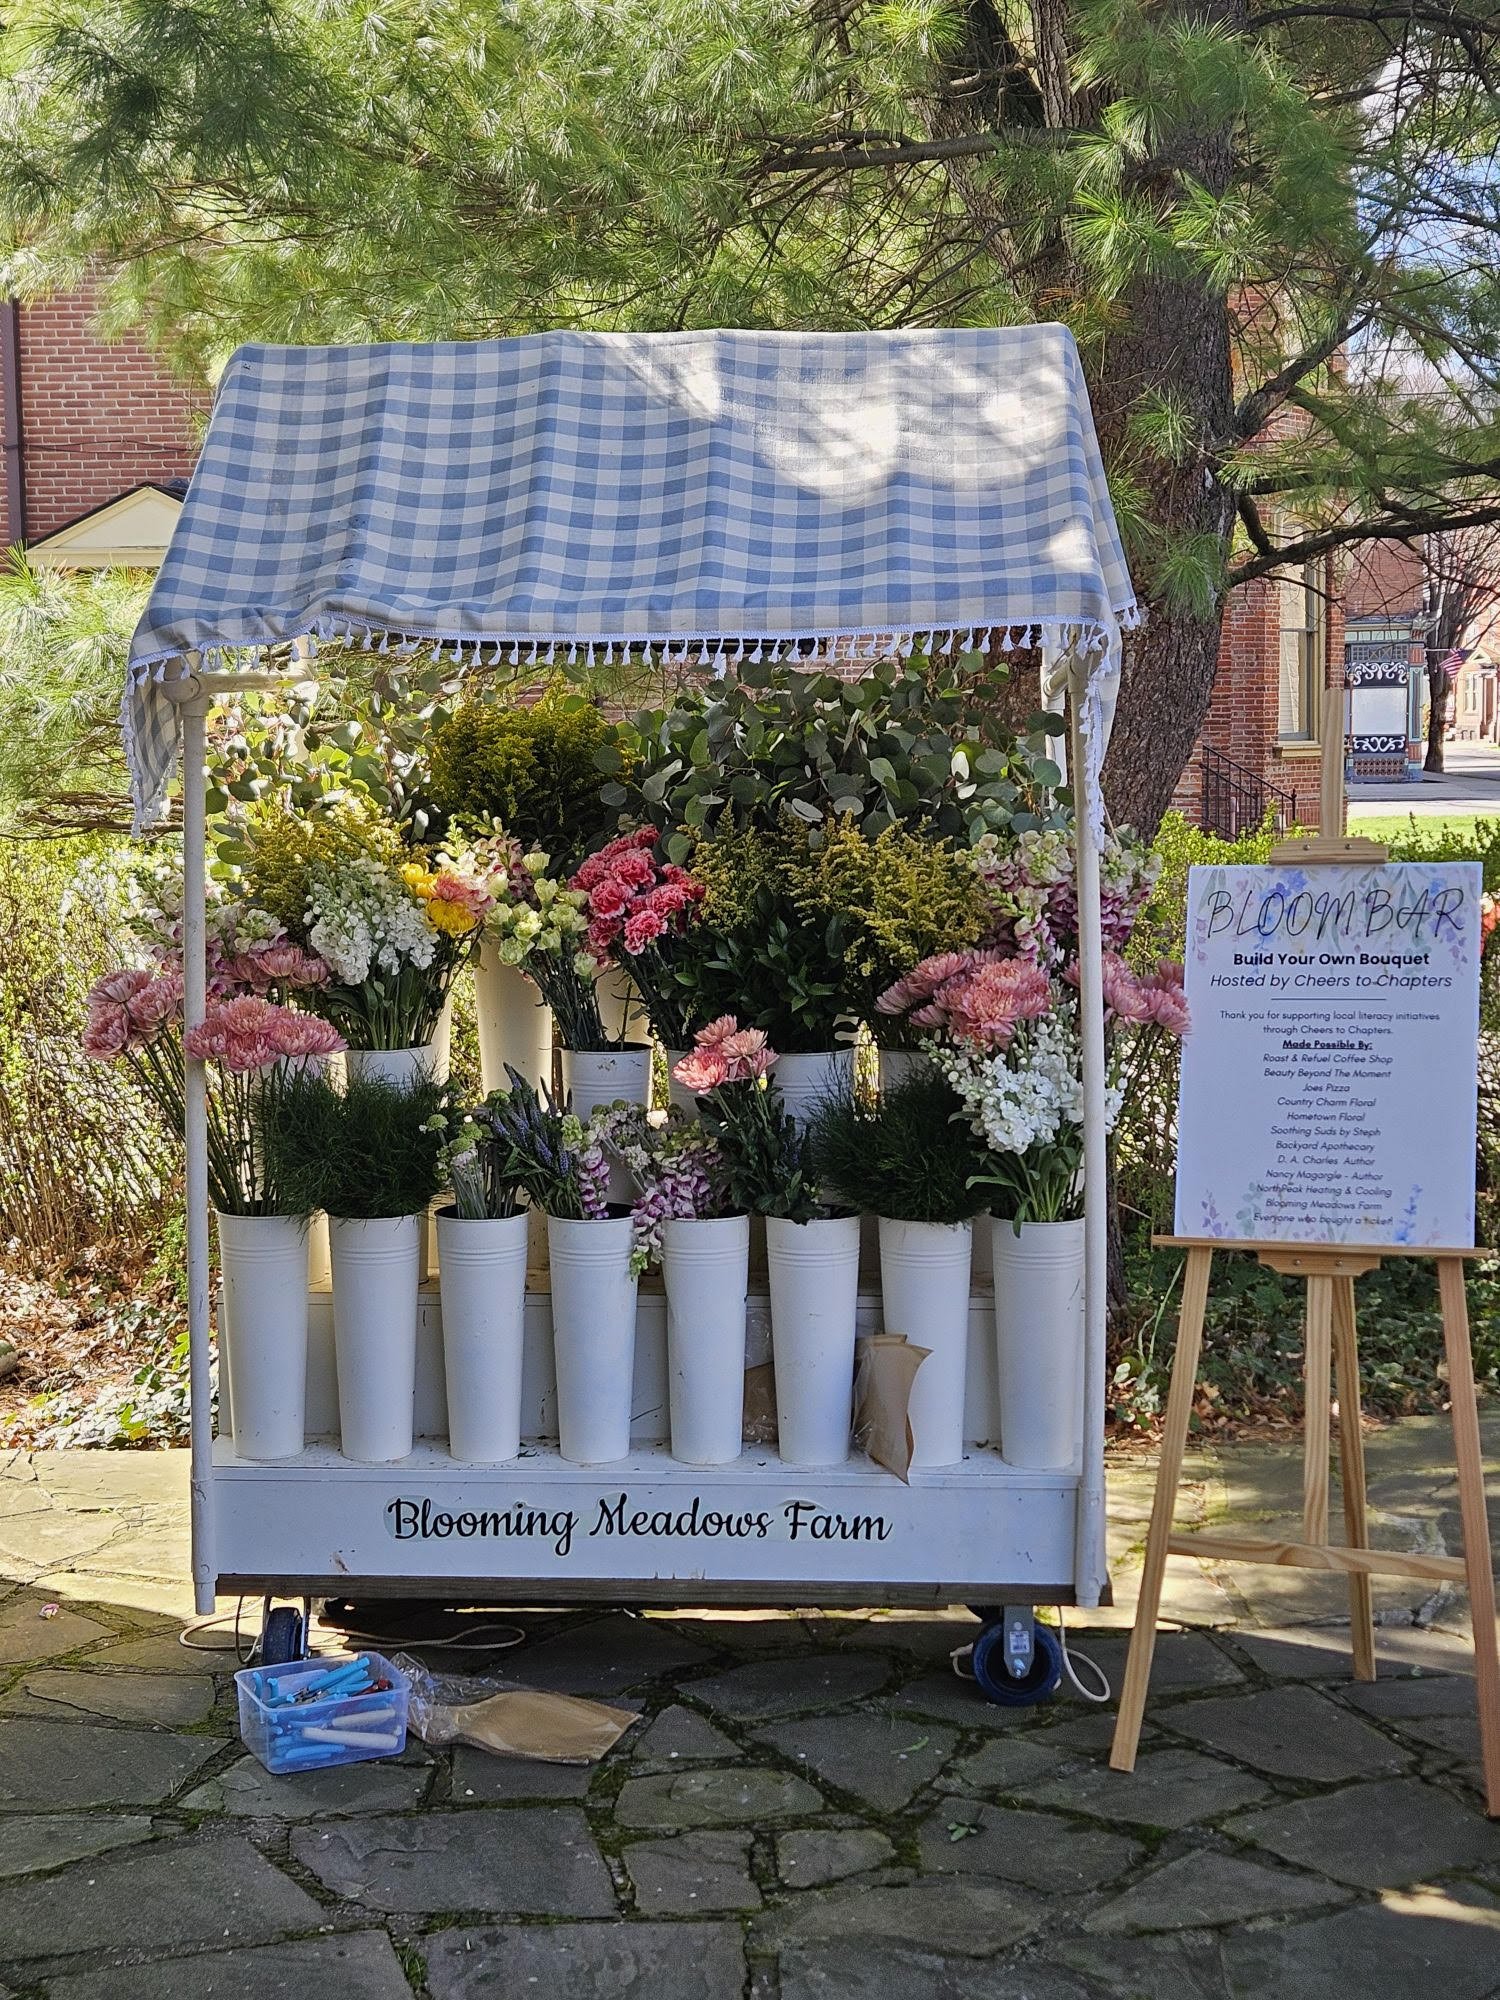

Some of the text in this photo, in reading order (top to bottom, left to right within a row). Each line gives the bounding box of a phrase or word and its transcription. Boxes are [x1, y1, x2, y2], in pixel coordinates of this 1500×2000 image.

[1207, 888, 1464, 940] BLOOM BAR
[1233, 952, 1430, 968] Build Your Own Bouquet
[1210, 974, 1453, 990] Hosted by Cheers to Chapters
[1220, 1010, 1441, 1022] Thank you for supporting local literacy initiatives
[1263, 1025, 1394, 1036] through Cheers to Chapters.
[1282, 1039, 1373, 1051] Made Possible By:
[1263, 1053, 1394, 1065] Roast & Refuel Coffee Shop
[1264, 1067, 1392, 1079] Beauty Beyond The Moment
[1302, 1083, 1350, 1092] Joes Pizza
[1277, 1097, 1377, 1108] Country Charm Floral
[1287, 1112, 1366, 1121] Hometown Floral
[1270, 1125, 1381, 1138] Soothing Suds by Steph
[1276, 1140, 1375, 1153] Backyard Apothecary
[1343, 1157, 1376, 1166] Author
[1266, 1169, 1294, 1180] Nancy
[1351, 1172, 1384, 1181] Author
[1256, 1184, 1393, 1198] NorthPeak Heating & Cooling
[1265, 1198, 1383, 1210] Blooming Meadows Farm
[1253, 1212, 1295, 1225] Everyone
[387, 1493, 894, 1556] Blooming Meadows Farm
